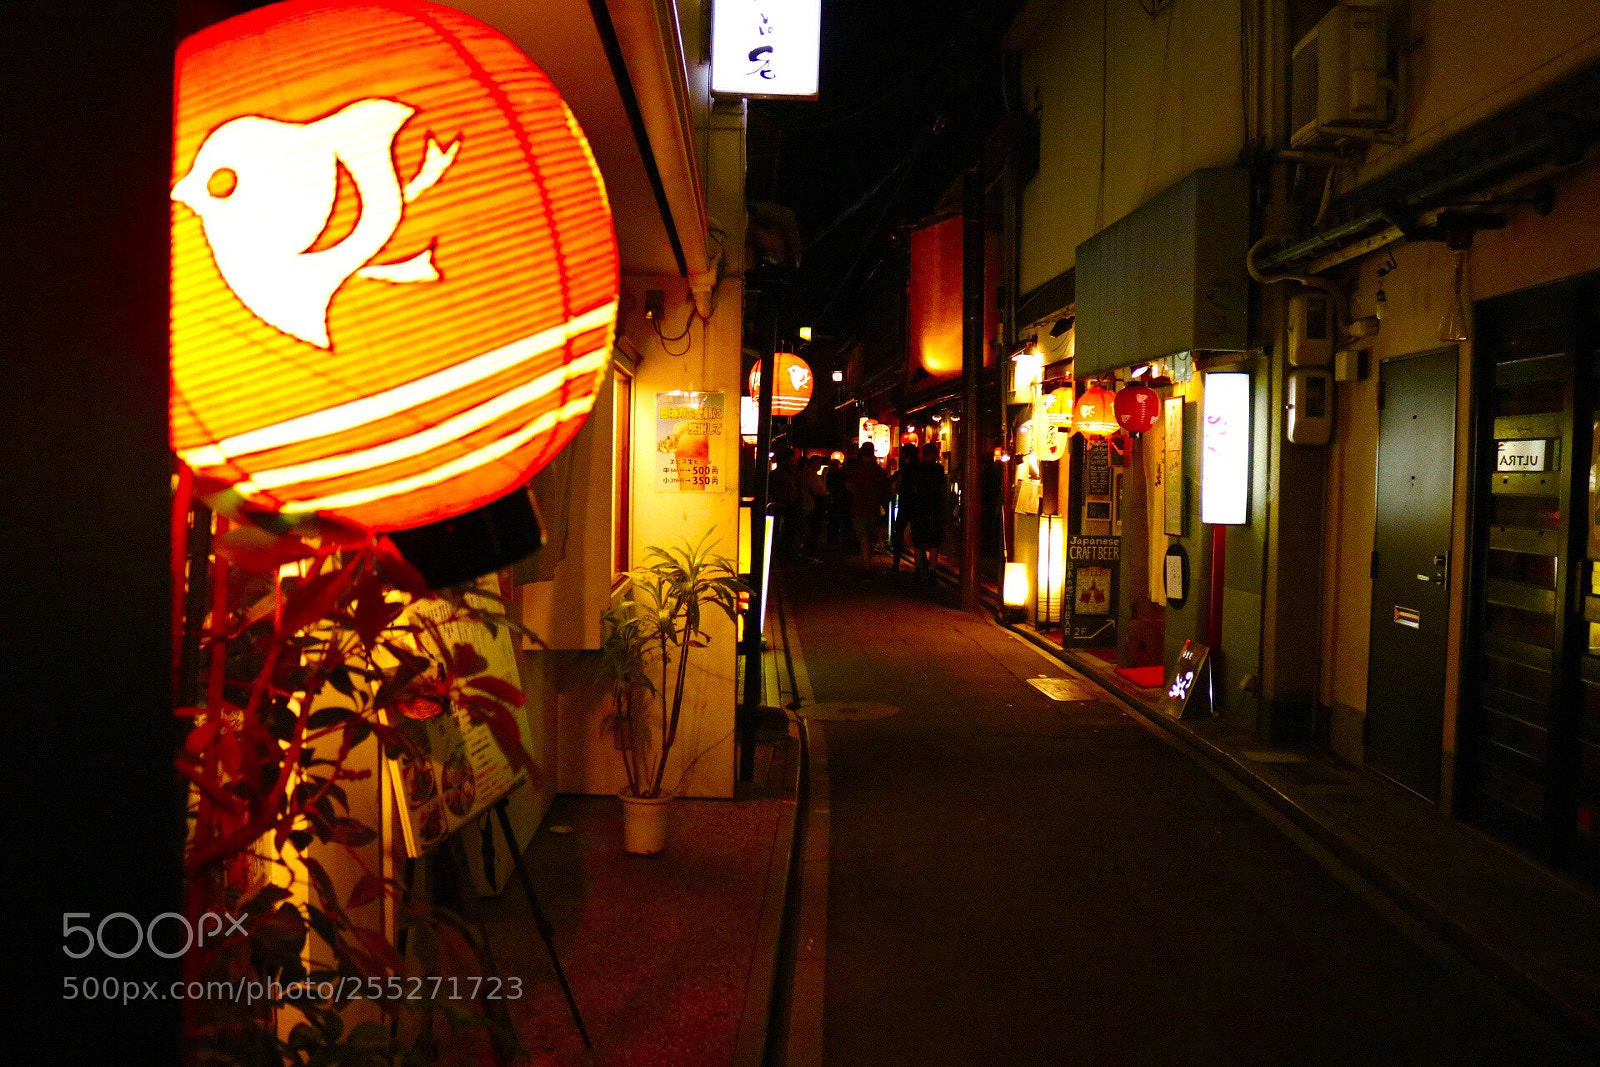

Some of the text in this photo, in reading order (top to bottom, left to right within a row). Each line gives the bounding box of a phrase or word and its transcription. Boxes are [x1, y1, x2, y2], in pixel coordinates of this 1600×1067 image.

[1070, 536, 1120, 546] Japanese
[1069, 546, 1120, 560] CRAFT BEER
[1074, 628, 1087, 636] 2F
